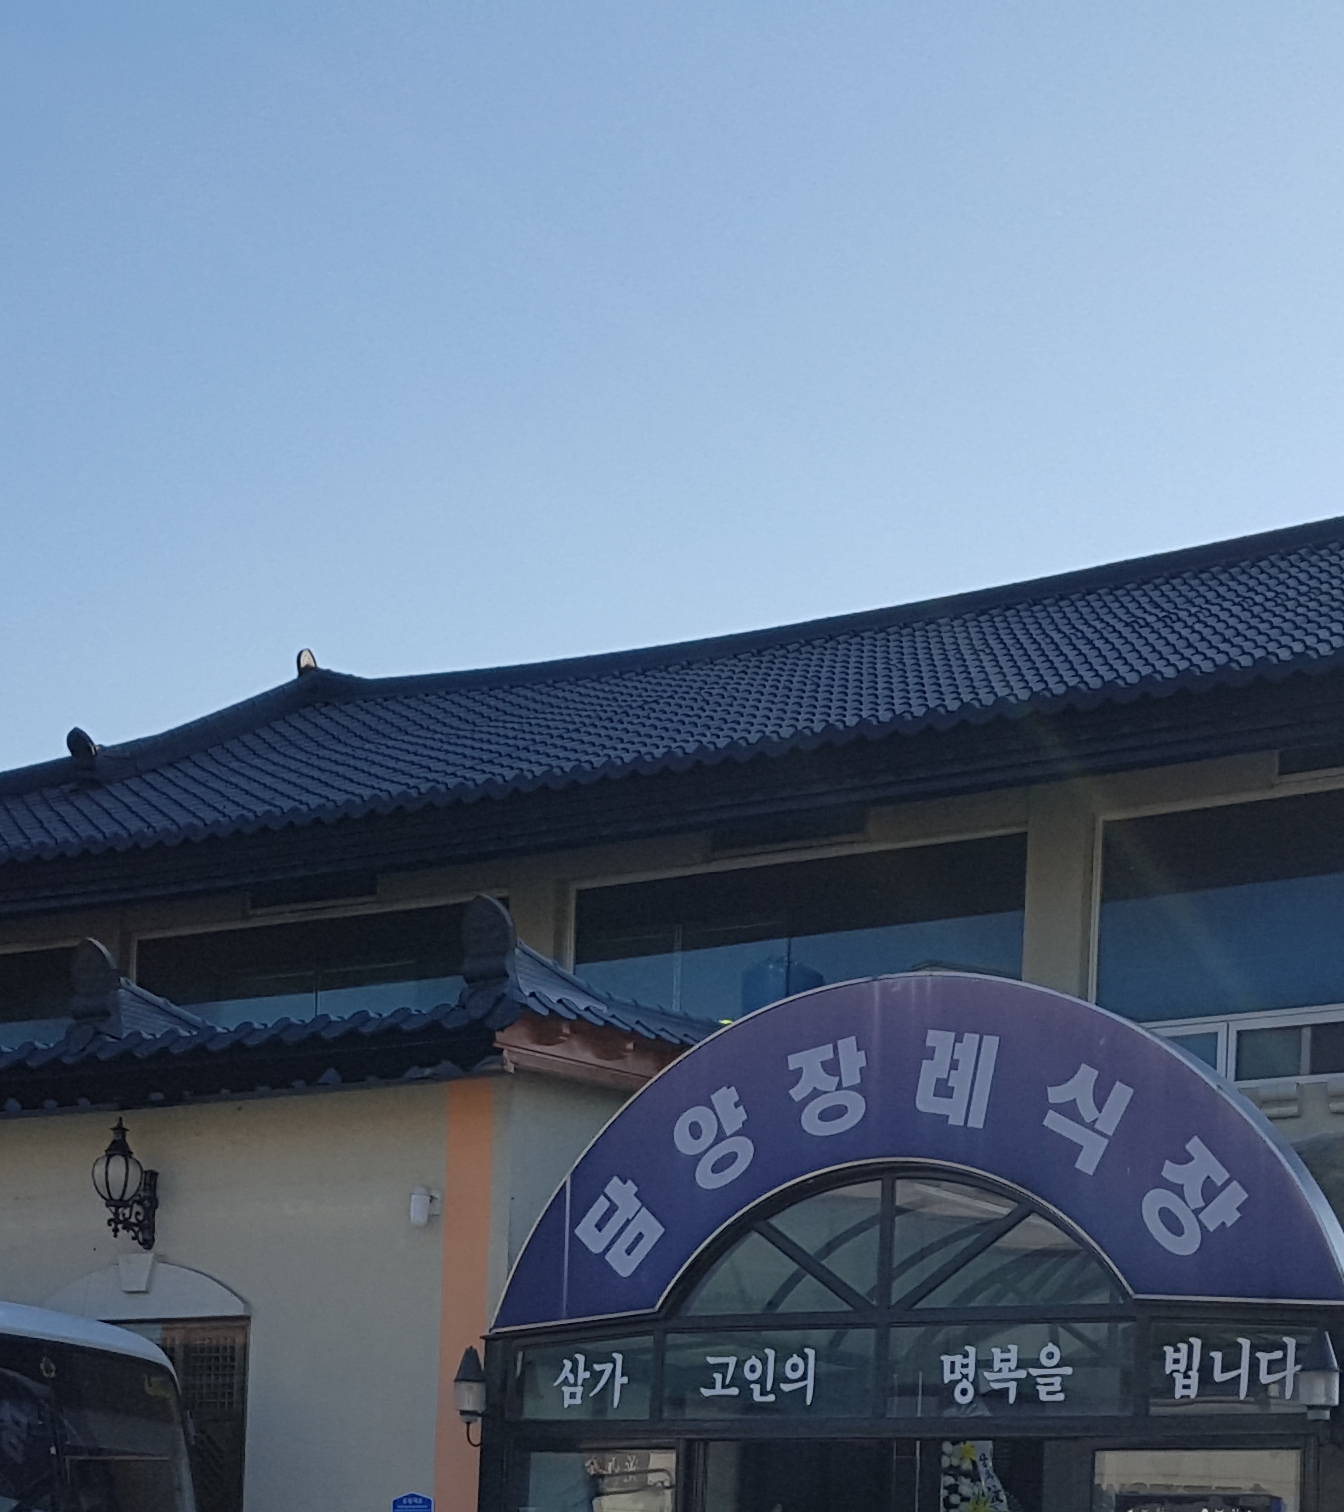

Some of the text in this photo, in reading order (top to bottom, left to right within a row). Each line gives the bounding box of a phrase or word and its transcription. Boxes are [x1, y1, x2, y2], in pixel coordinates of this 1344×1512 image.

[574, 1029, 1250, 1277] 담양장례식장
[553, 1336, 1302, 1408] 삼가 고인의 명복을 빕니다
